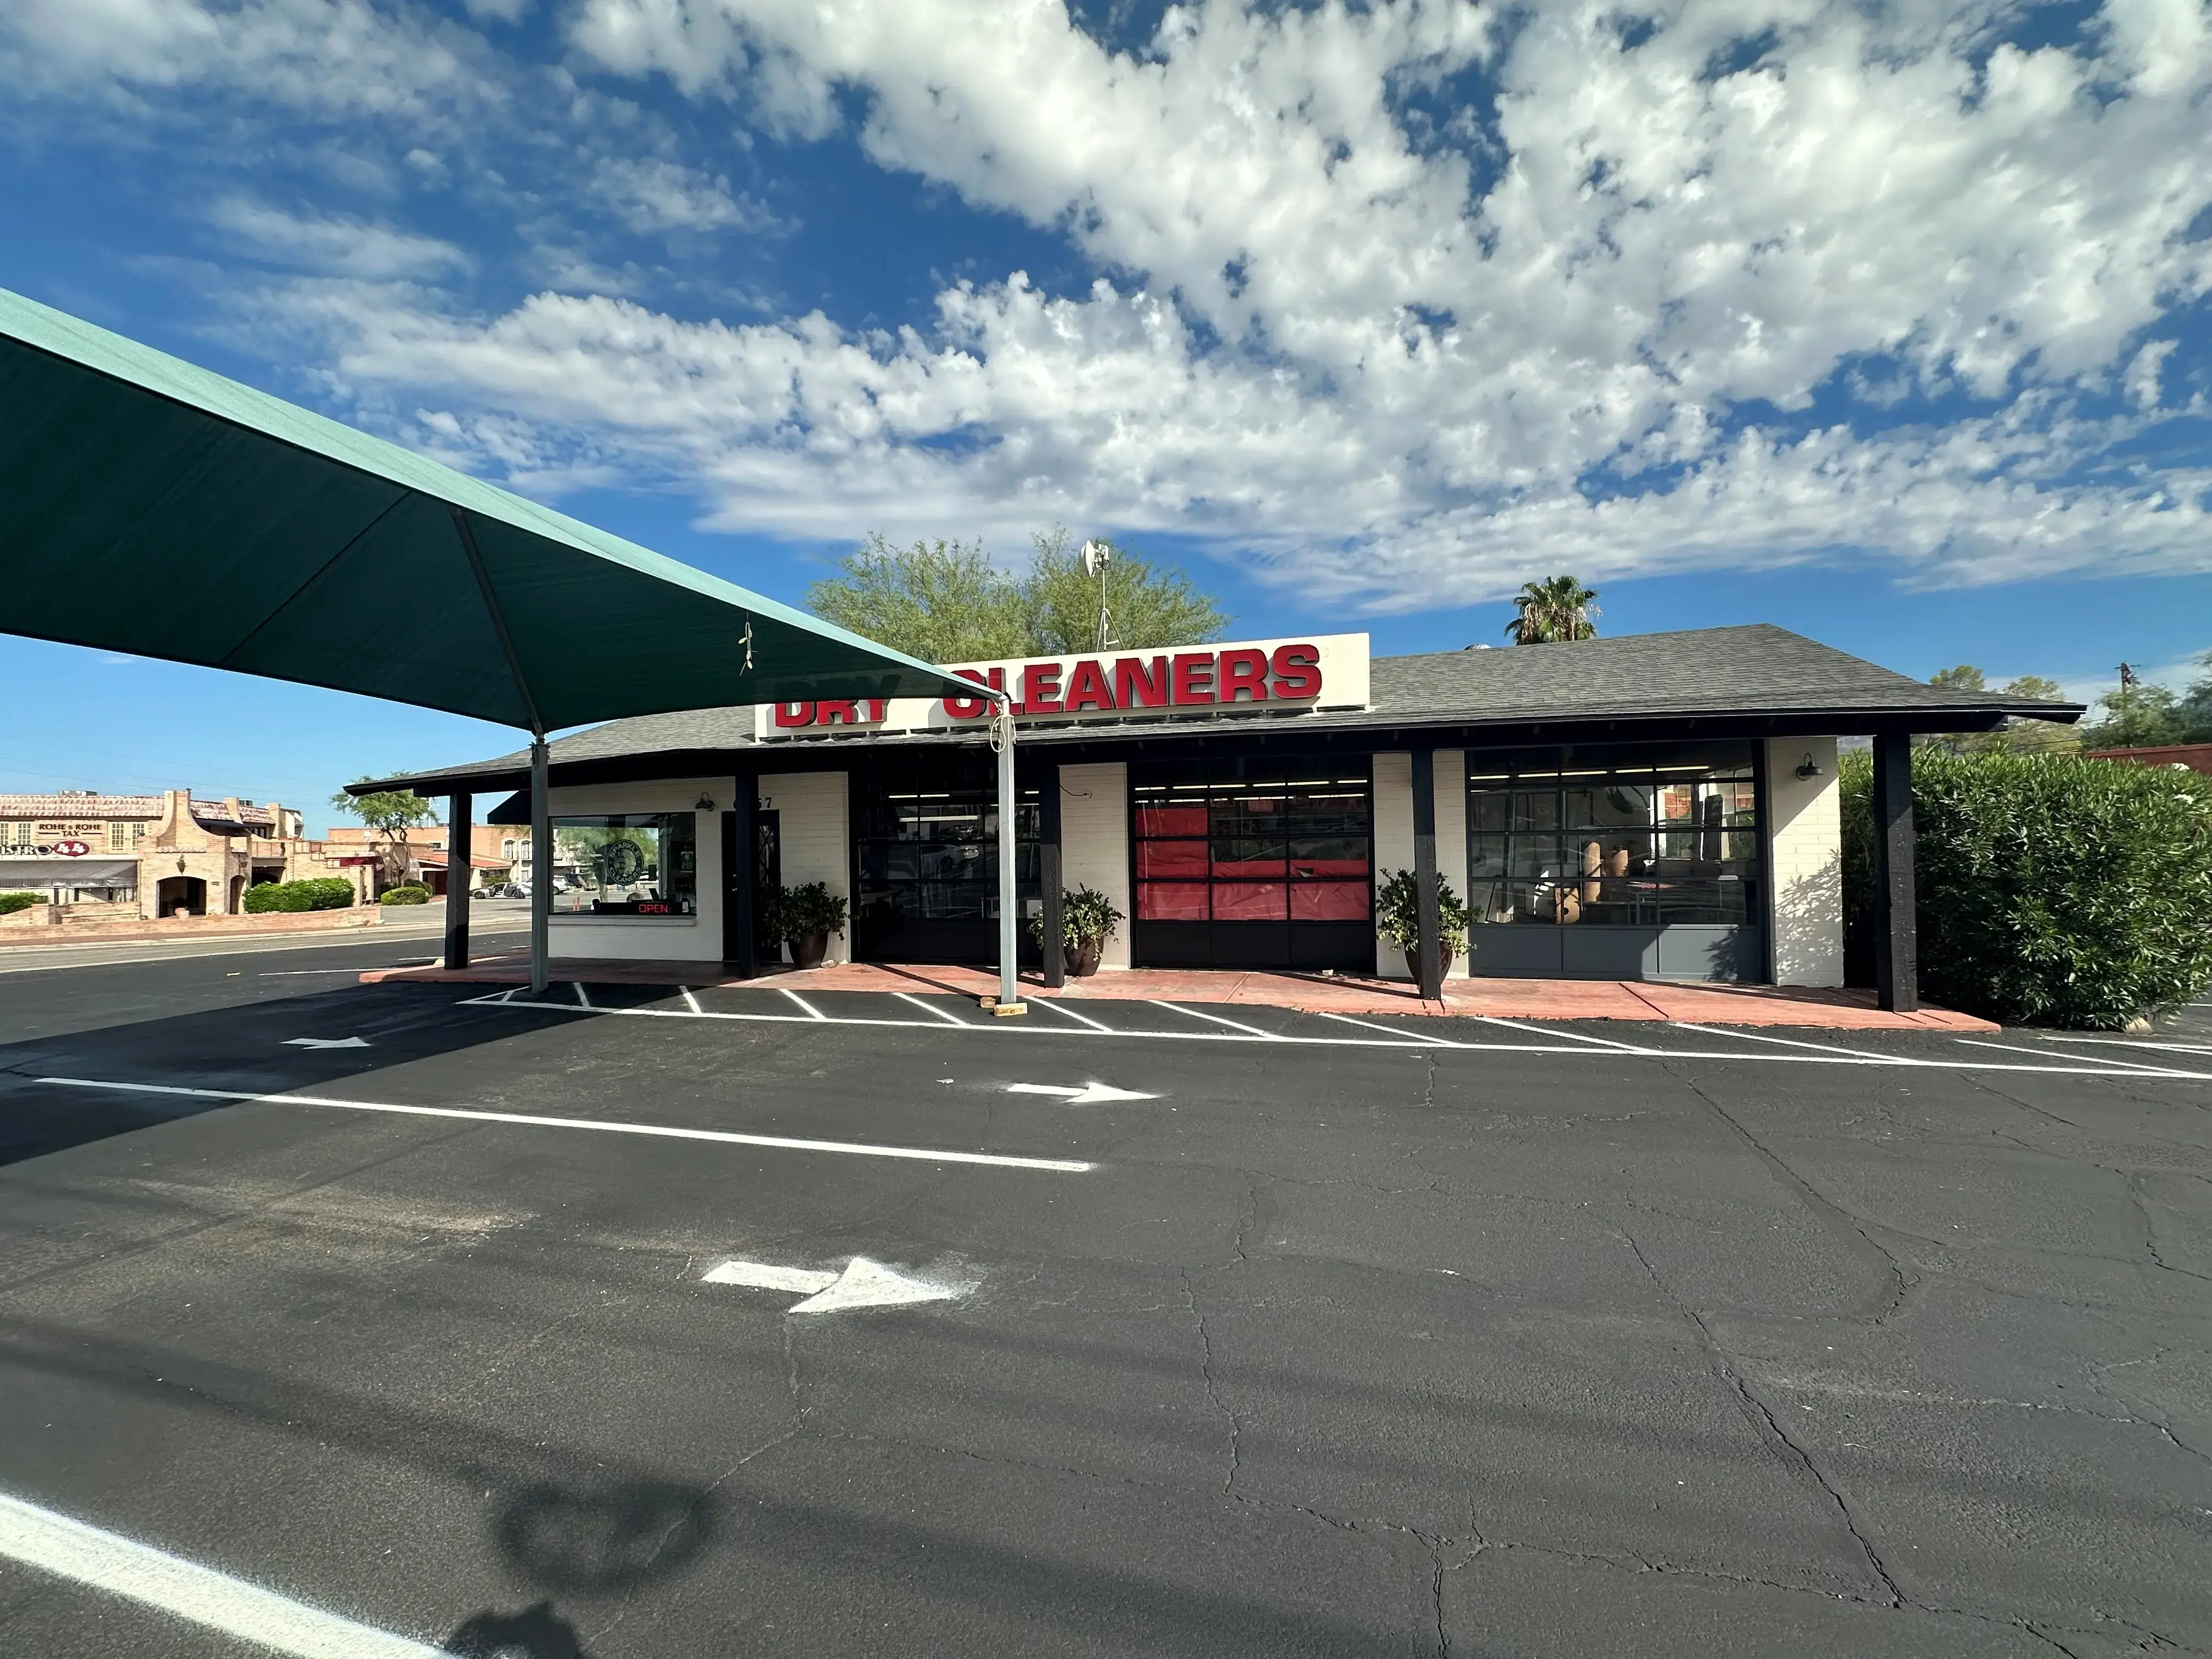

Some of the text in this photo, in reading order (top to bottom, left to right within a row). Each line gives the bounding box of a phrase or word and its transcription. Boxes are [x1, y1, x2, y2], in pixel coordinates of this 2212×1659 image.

[943, 644, 1323, 720] CLEANERS
[0, 843, 85, 855] ISTRO 44
[610, 842, 641, 859] SPARKLE
[610, 867, 641, 883] CLEANERS
[639, 904, 668, 913] OPEN
